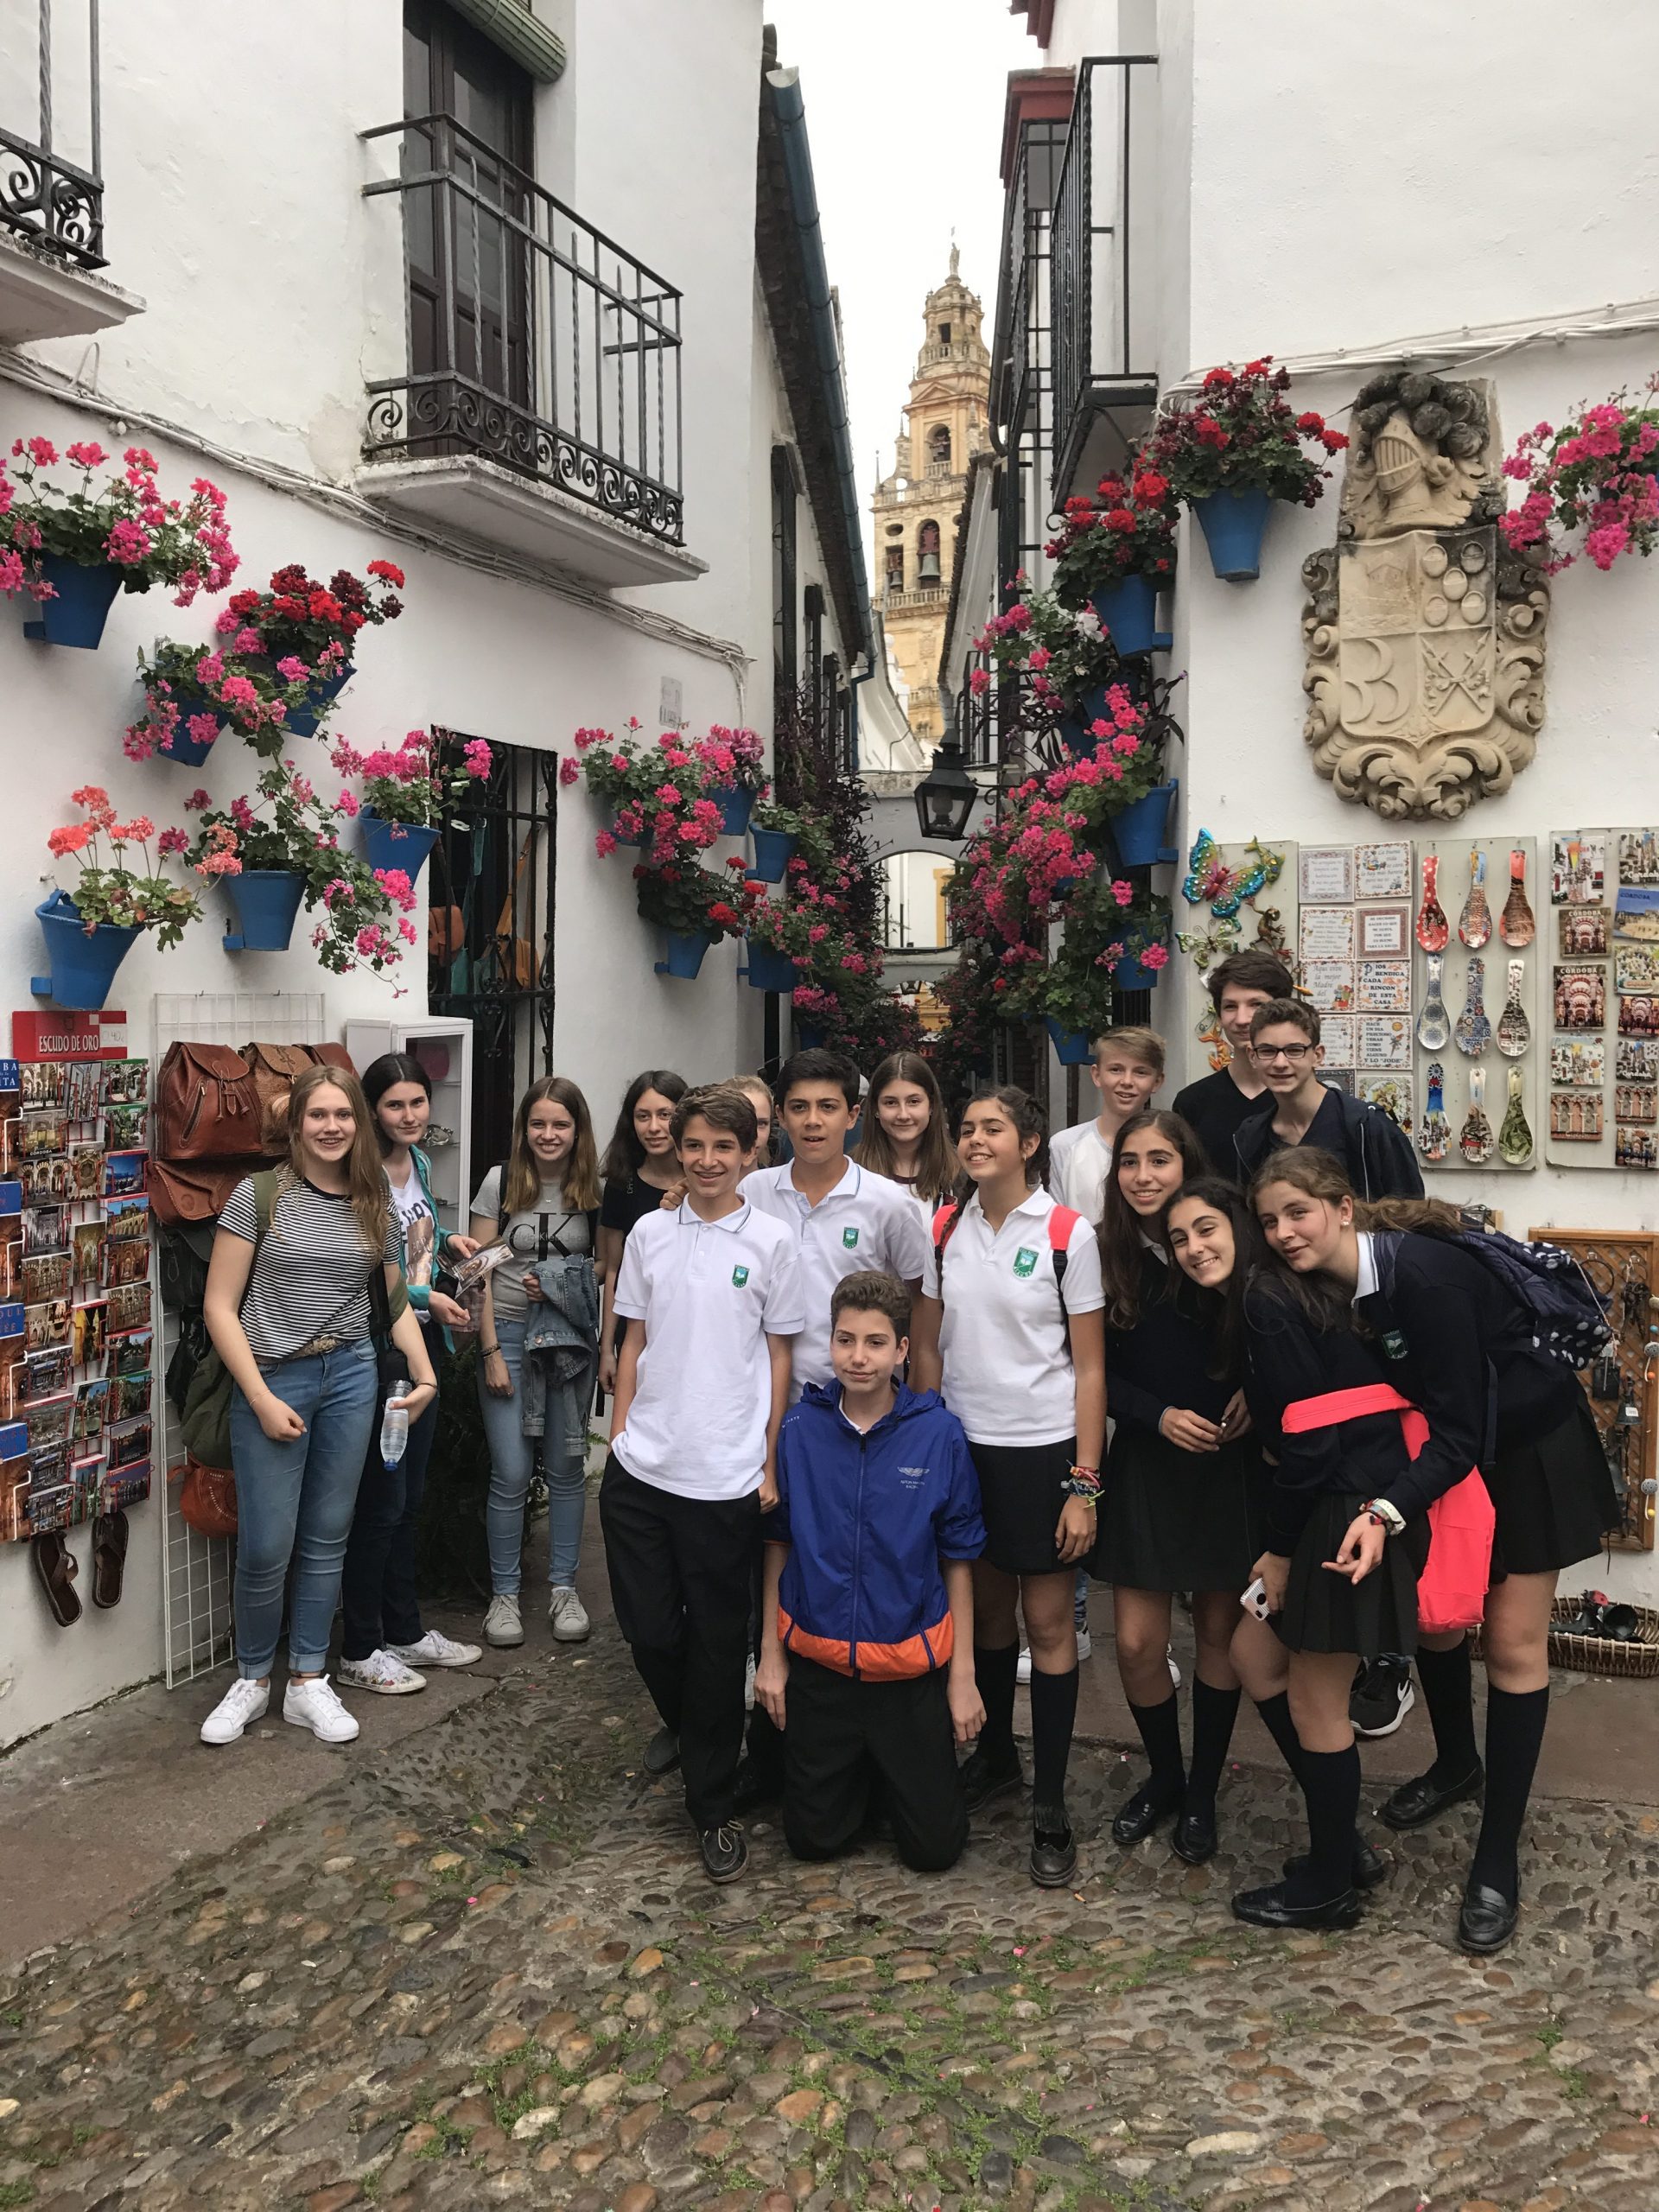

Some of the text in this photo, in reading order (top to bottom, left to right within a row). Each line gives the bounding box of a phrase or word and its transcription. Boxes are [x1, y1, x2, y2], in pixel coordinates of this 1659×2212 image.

[39, 1034, 99, 1052] ESCUDO DE ORO
[3, 1062, 17, 1071] BA
